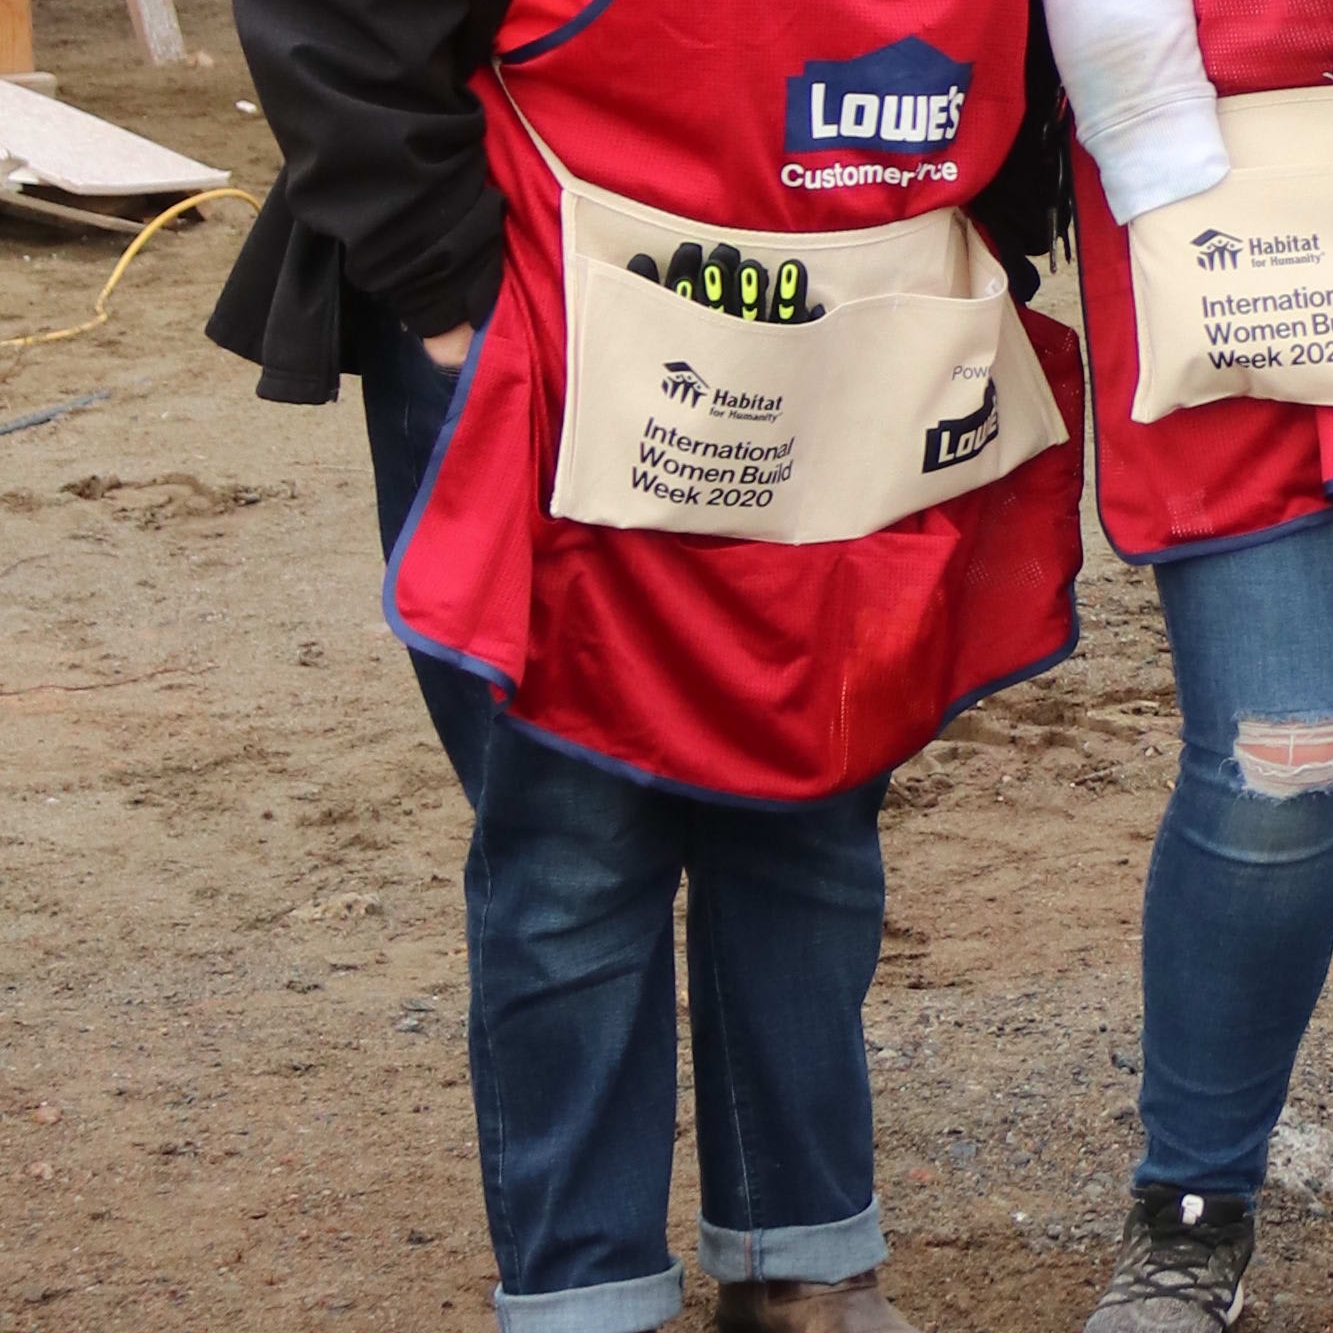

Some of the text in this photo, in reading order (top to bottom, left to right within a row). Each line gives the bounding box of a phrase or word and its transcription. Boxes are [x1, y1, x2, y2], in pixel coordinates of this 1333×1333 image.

[811, 83, 966, 143] LOWE'S
[781, 162, 916, 190] Customer
[1249, 234, 1320, 256] Habitat
[1251, 253, 1322, 268] for Humanity
[1205, 320, 1308, 346] Women
[1208, 346, 1284, 370] Week
[713, 389, 783, 411] Habitat
[709, 407, 778, 424] for Humanity
[643, 416, 795, 462] International
[639, 441, 795, 485] Women Build
[632, 465, 774, 507] Week 2020
